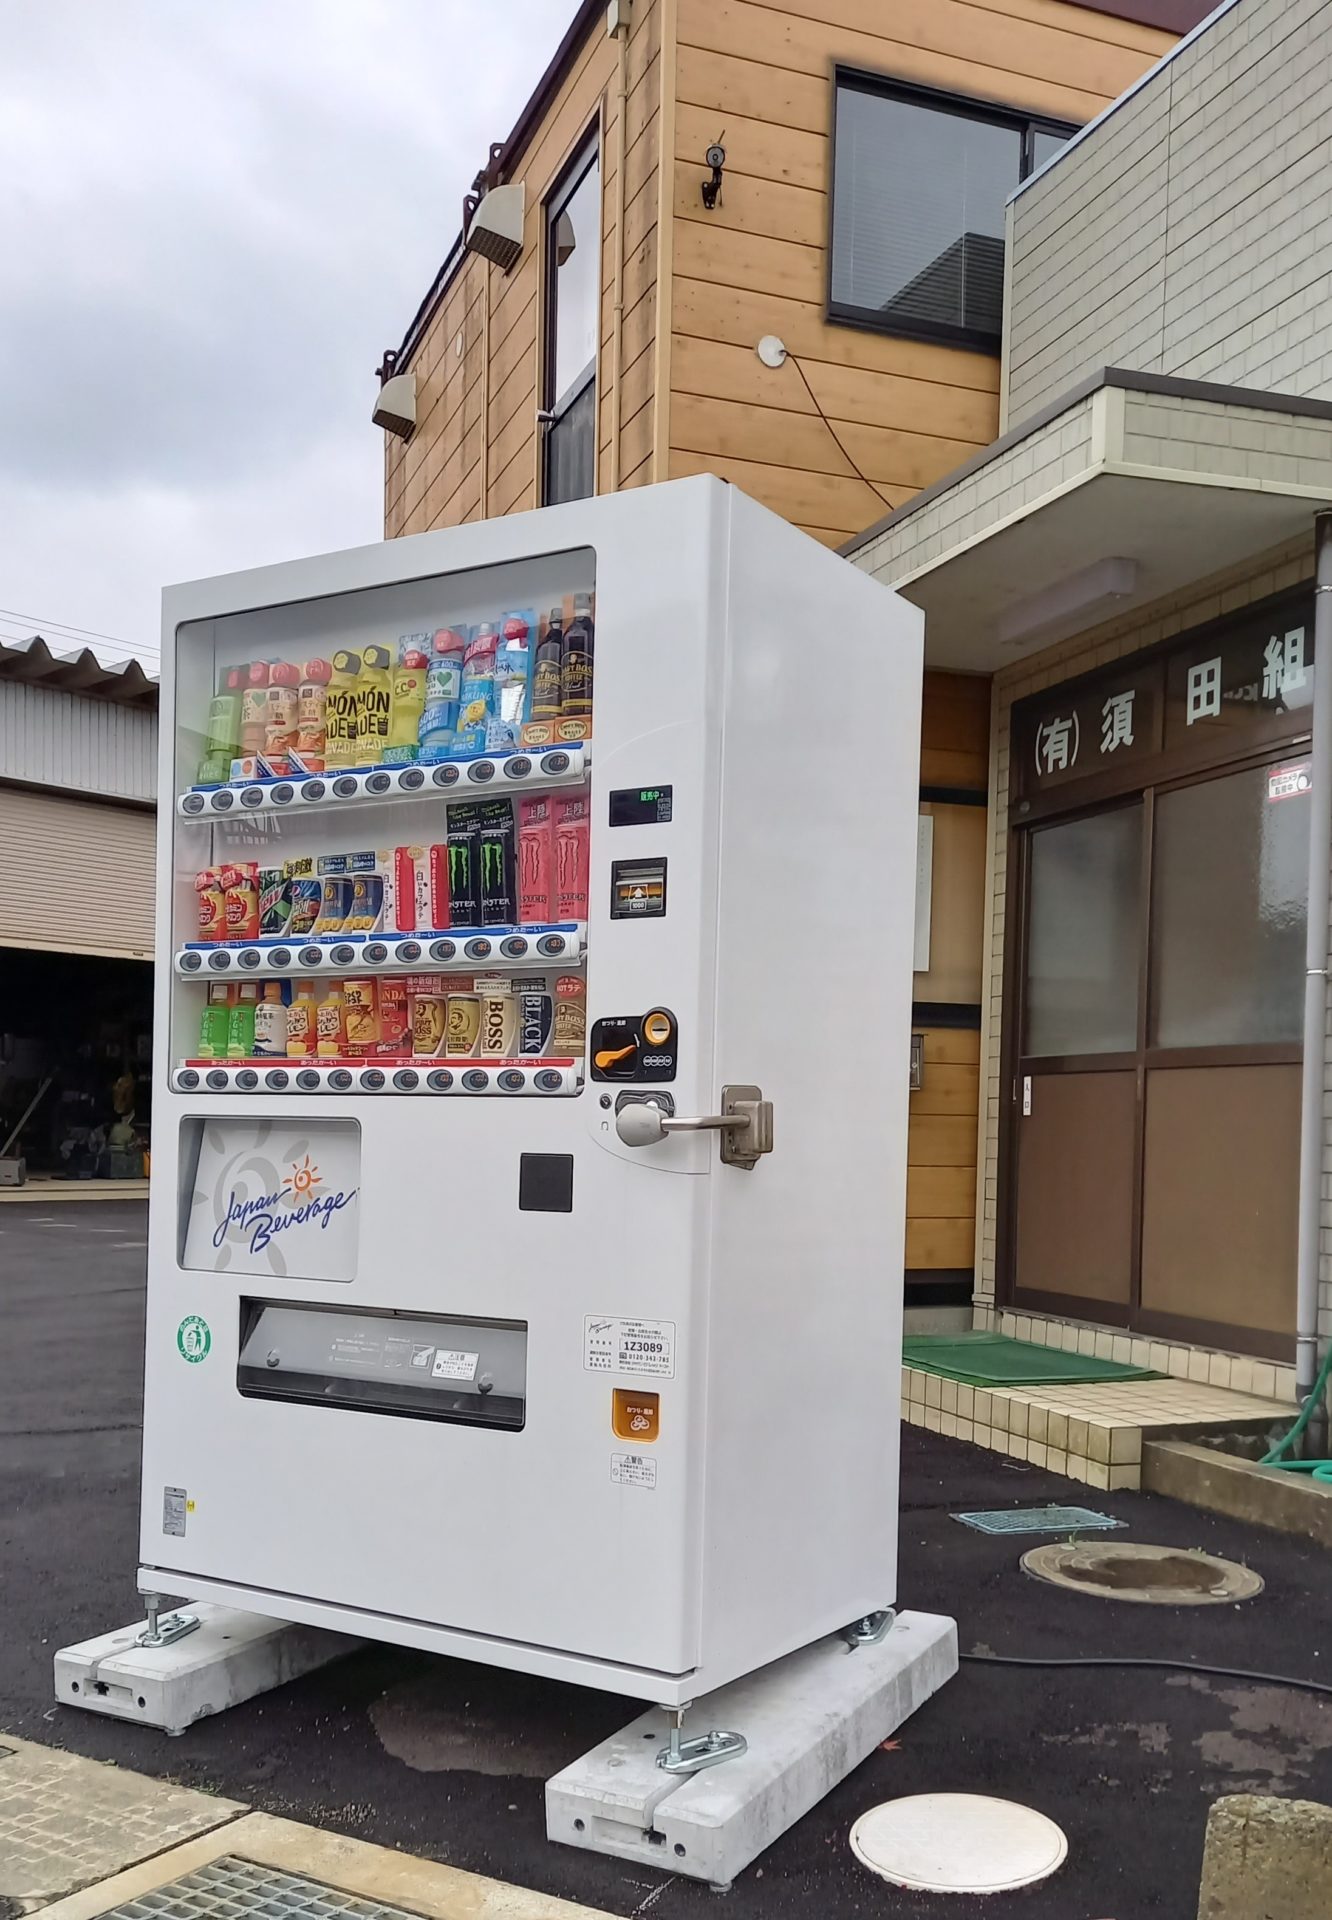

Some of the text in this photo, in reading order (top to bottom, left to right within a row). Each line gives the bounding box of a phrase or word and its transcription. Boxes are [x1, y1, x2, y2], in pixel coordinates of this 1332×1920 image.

[488, 1000, 504, 1050] BOSS
[524, 995, 542, 1050] BLACK
[213, 1187, 292, 1247] Japan
[245, 1187, 360, 1254] Beverage
[624, 1341, 663, 1353] 1Z3089
